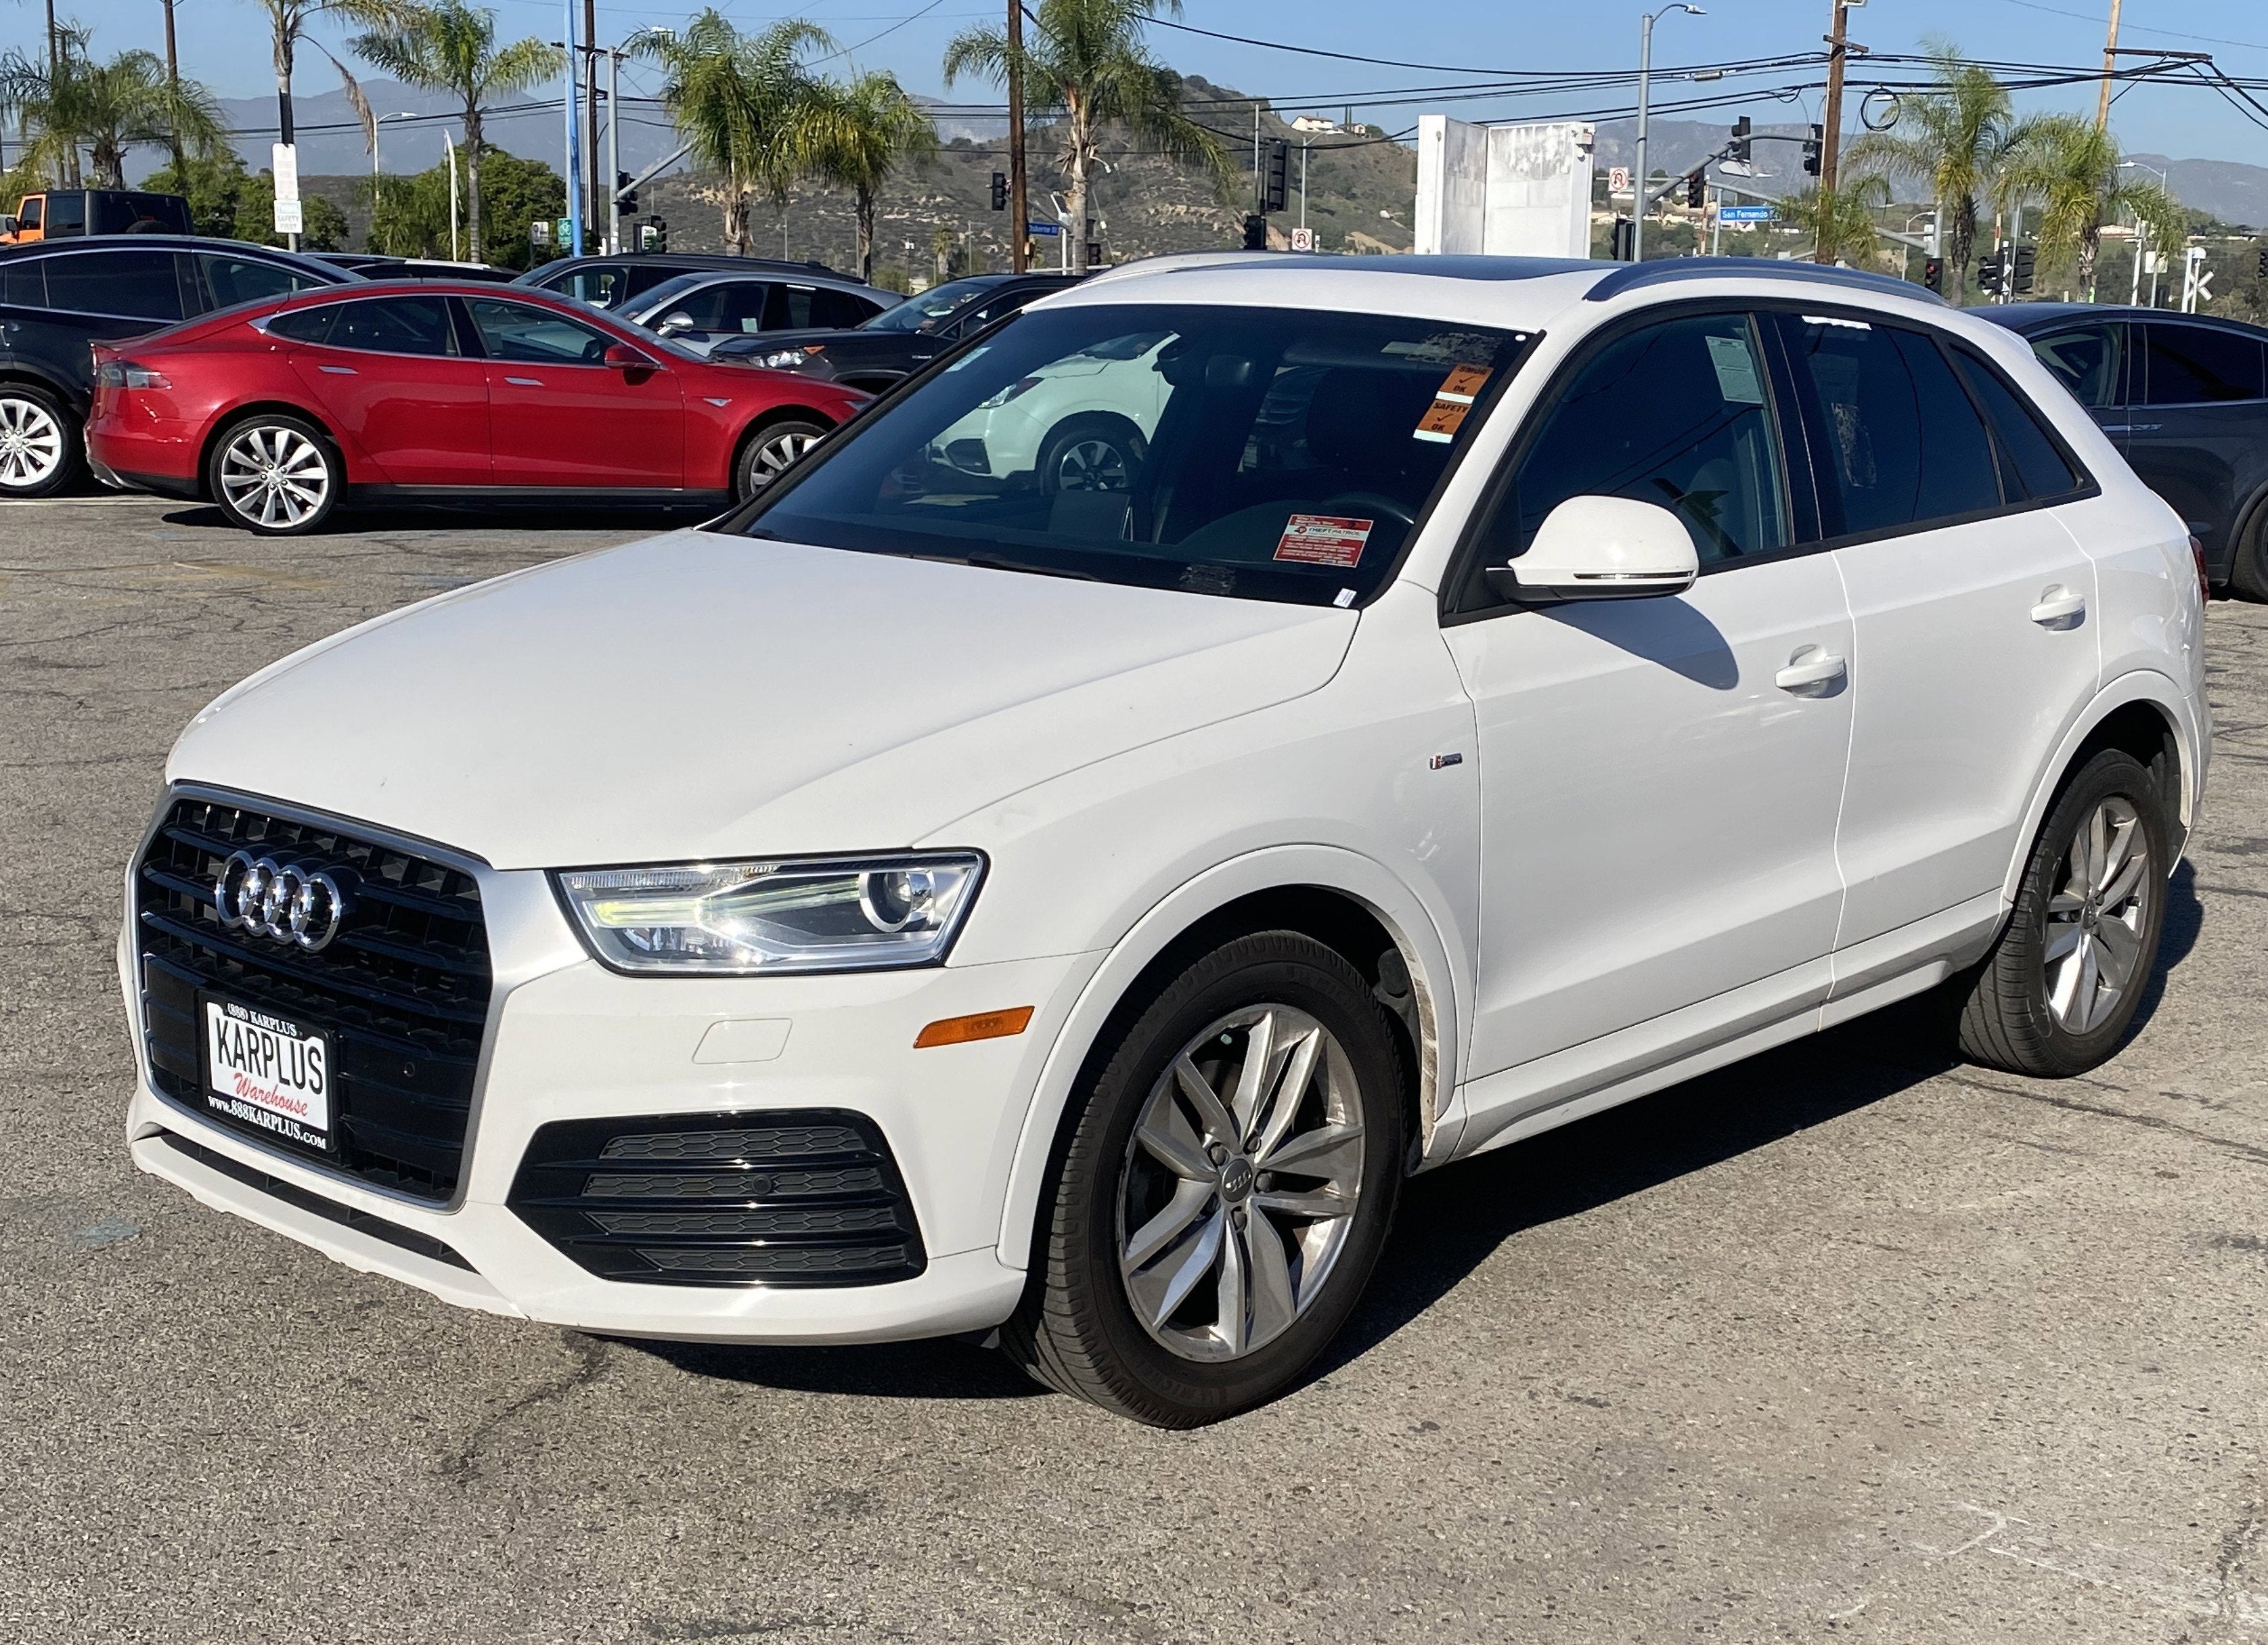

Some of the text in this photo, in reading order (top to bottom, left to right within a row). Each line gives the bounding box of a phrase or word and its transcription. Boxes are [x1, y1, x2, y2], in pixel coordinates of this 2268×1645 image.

[1737, 210, 1768, 218] Fernando
[1459, 366, 1487, 375] SMOG
[1433, 403, 1469, 413] SAFETY
[1431, 424, 1446, 432] OK
[227, 1003, 297, 1037] (888) KARPLUS
[216, 1017, 324, 1095] KARPLUS
[234, 1072, 308, 1117] Warehouse
